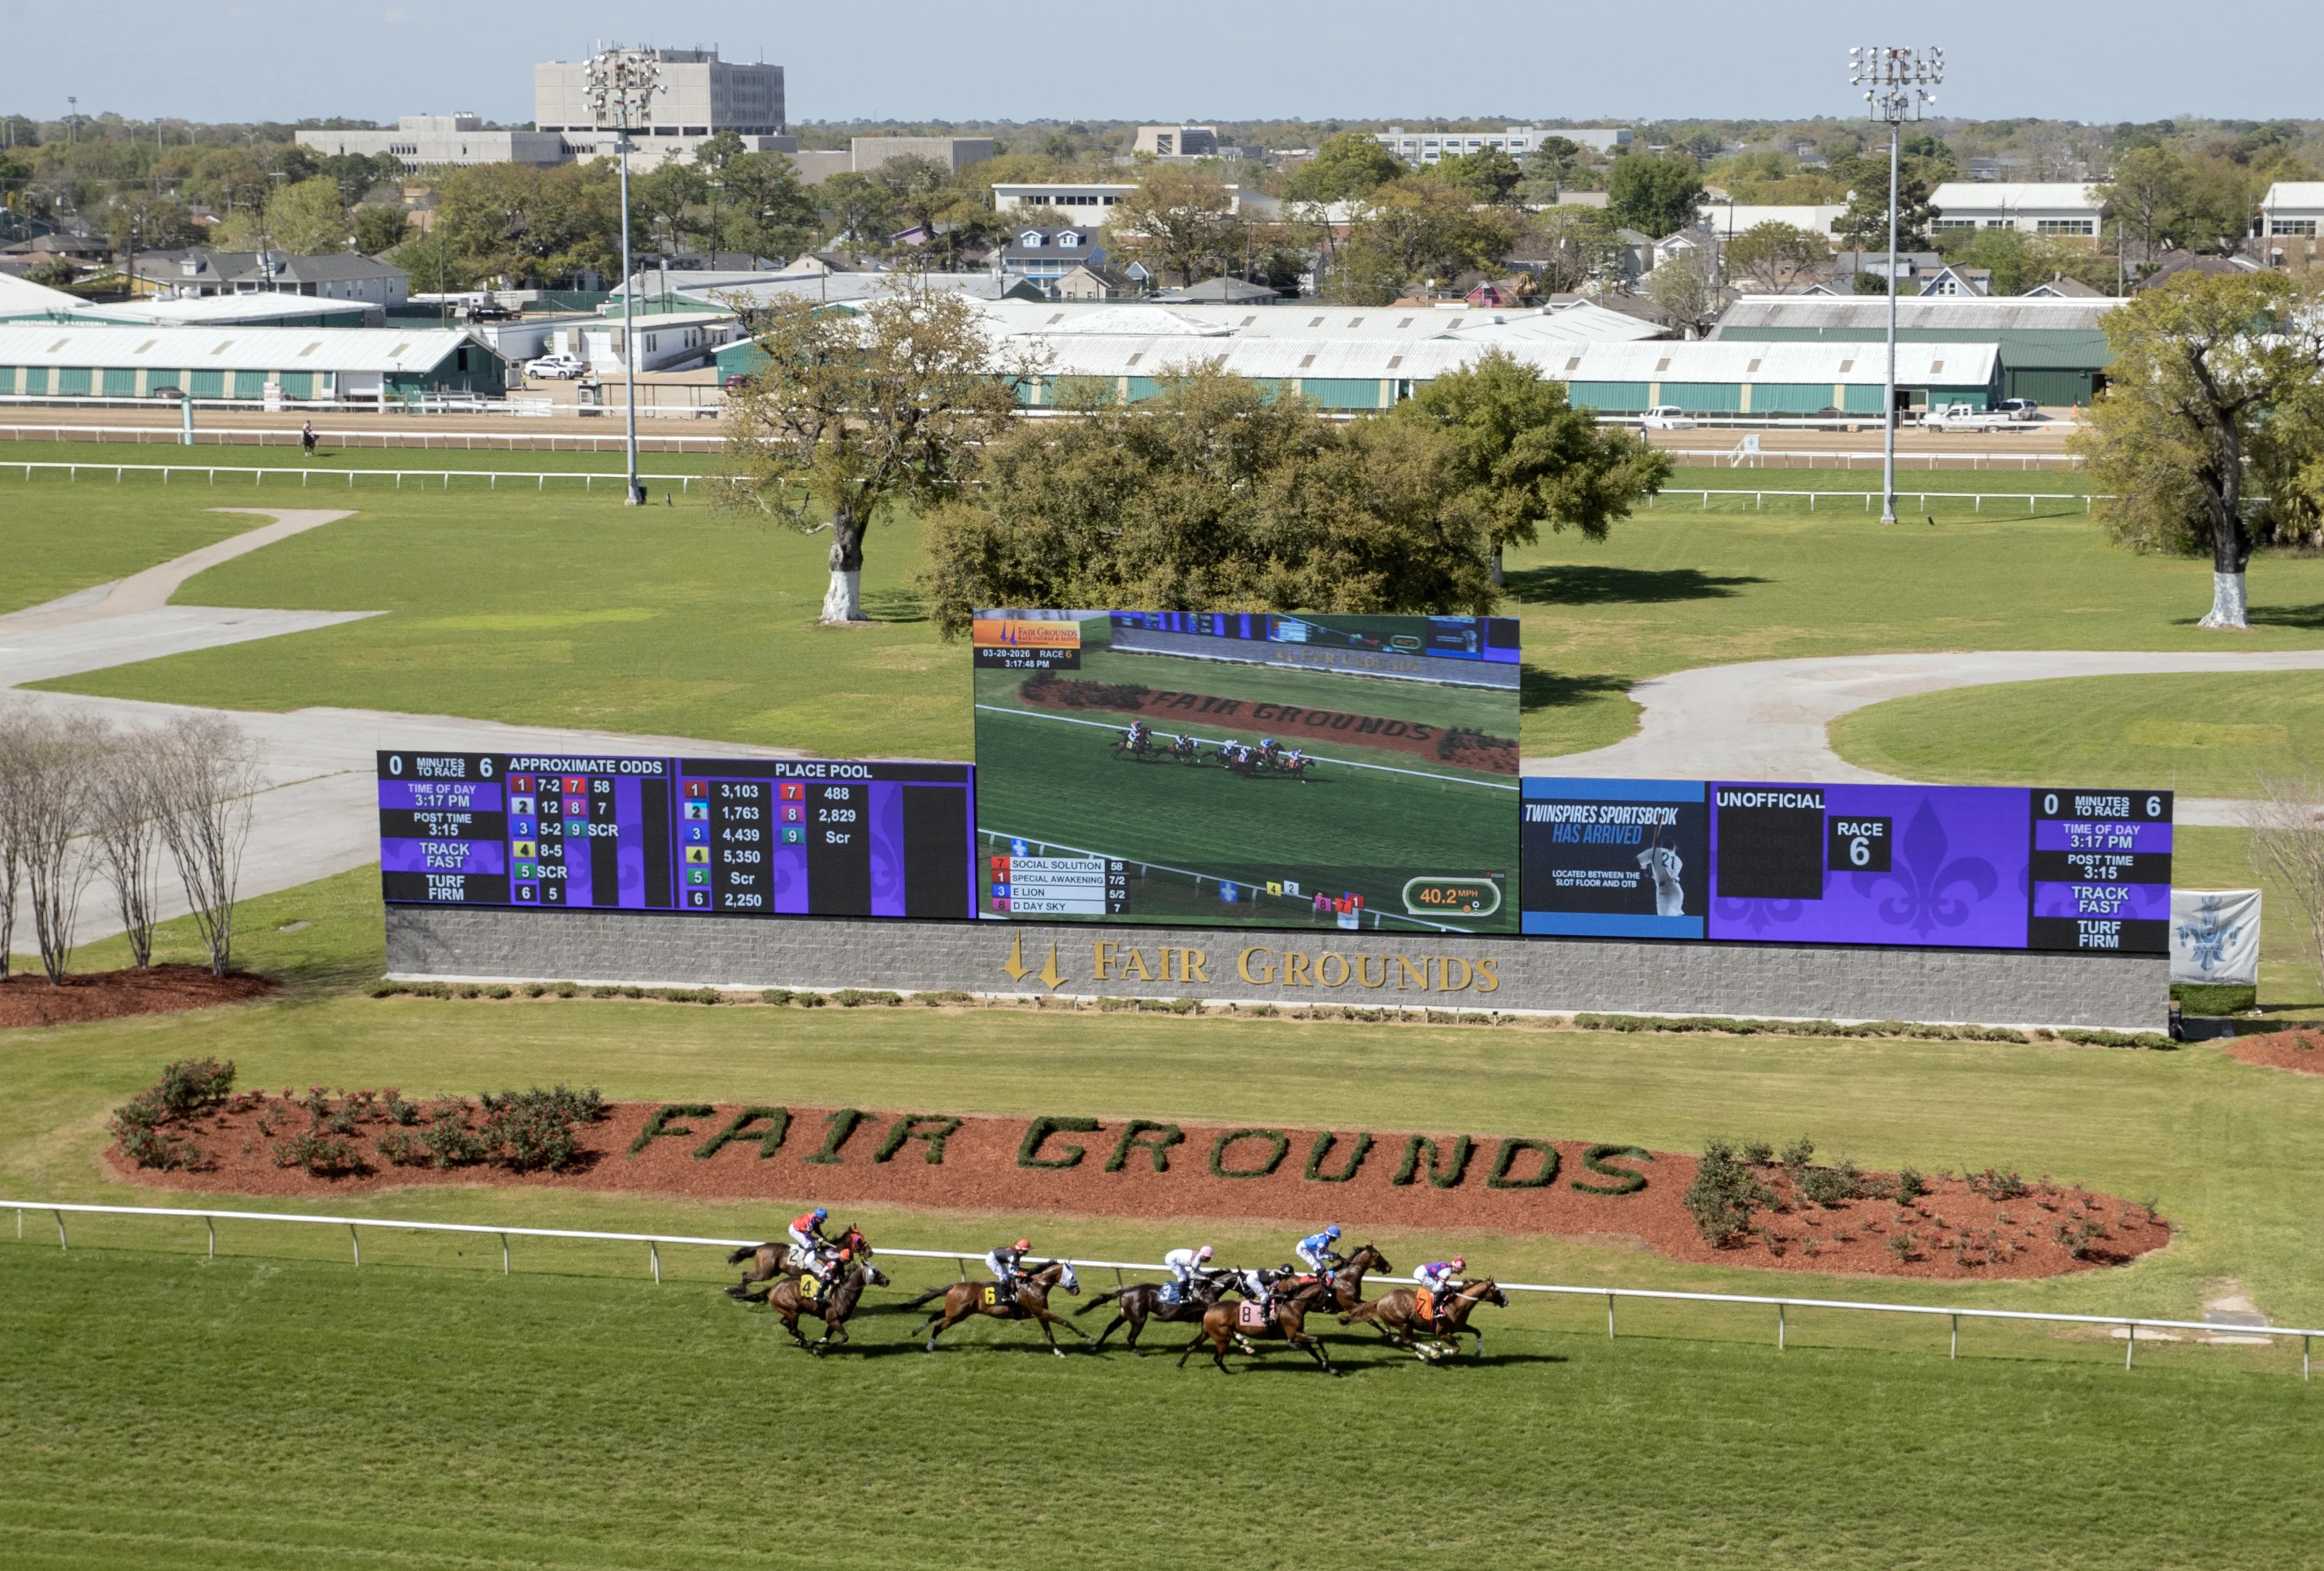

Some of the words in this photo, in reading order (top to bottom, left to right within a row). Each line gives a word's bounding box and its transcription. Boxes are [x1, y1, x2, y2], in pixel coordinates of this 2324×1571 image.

[1018, 627, 1035, 636] FAIR
[1037, 627, 1077, 636] GROUNDS
[1150, 690, 1239, 716] FAIR
[1251, 702, 1436, 741] GROUNDS
[389, 755, 402, 775] 0
[417, 758, 465, 768] MINUTES
[480, 758, 493, 777] 6
[509, 758, 615, 773] APPROXIMATE
[619, 760, 663, 773] ODDS
[417, 768, 431, 777] TO
[433, 768, 465, 777] RACE
[776, 764, 825, 777] PLACE
[830, 766, 872, 778] POOL
[408, 784, 434, 793] TIME
[436, 785, 451, 793] OF
[454, 785, 476, 795] DAY
[518, 779, 525, 791] 1
[538, 781, 560, 792] 7-2
[571, 781, 579, 792] 7
[594, 781, 610, 793] 58
[692, 785, 698, 796] 1
[721, 785, 759, 798] 3,103
[789, 787, 796, 798] 7
[824, 788, 849, 800] 488
[416, 795, 445, 807] 3:17
[448, 796, 470, 808] PM
[519, 800, 527, 813] 2
[542, 801, 558, 813] 12
[572, 802, 580, 814] 8
[598, 803, 606, 815] 7
[1717, 792, 1825, 809] UNOFFICIAL
[2044, 794, 2058, 815] 0
[2075, 796, 2129, 806] MINUTES
[2146, 796, 2161, 817] 6
[414, 813, 443, 822] POST
[446, 814, 472, 823] TIME
[692, 805, 700, 818] 2
[723, 807, 759, 820] 1,763
[789, 809, 796, 820] 8
[819, 809, 856, 822] 2,829
[1526, 804, 1597, 823] TWINSPIRES
[1599, 806, 1678, 825] SPORTSBOOK
[2075, 806, 2091, 816] TO
[2095, 806, 2129, 817] RACE
[429, 824, 458, 835] 3:15
[519, 822, 528, 834] 3
[540, 824, 561, 835] 5-2
[572, 824, 580, 835] 9
[588, 824, 619, 837] SCR
[693, 828, 700, 839] 3
[723, 829, 759, 841] 4,439
[789, 831, 797, 843] 9
[826, 831, 850, 843] Scr
[1552, 824, 1580, 843] HAS
[1582, 824, 1642, 845] ARRIVED
[1837, 822, 1883, 836] RACE
[2063, 824, 2091, 834] TIME
[2096, 824, 2112, 835] OF
[2116, 826, 2140, 835] DAY
[419, 842, 470, 856] TRACK
[2070, 835, 2101, 848] 3:17
[2108, 836, 2133, 849] PM
[520, 844, 529, 856] 4
[541, 845, 562, 856] 8-5
[693, 849, 702, 861] 4
[723, 851, 760, 864] 5,350
[1850, 836, 1870, 866] 6
[427, 856, 463, 868] FAST
[998, 859, 1004, 867] 7
[1052, 862, 1101, 870] SOLUTION
[1661, 852, 1675, 869] 21
[2069, 854, 2101, 865] POST
[2104, 855, 2133, 866] TIME
[521, 866, 529, 877] 5
[537, 866, 567, 879] SCR
[695, 872, 702, 883] 5
[730, 873, 754, 884] Scr
[998, 873, 1004, 881] 1
[1588, 871, 1624, 879] BETWEEN
[2084, 866, 2118, 879] 3:15
[426, 875, 465, 887] TURF
[429, 888, 464, 901] FIRM
[521, 887, 531, 899] 6
[549, 888, 557, 899] 5
[998, 887, 1005, 896] 3
[1270, 885, 1277, 894] 4
[1289, 884, 1294, 893] 2
[2072, 886, 2129, 900] TRACK
[695, 893, 703, 905] 6
[725, 894, 762, 907] 2,250
[1354, 897, 1358, 907] 1
[1420, 888, 1457, 904] 40.2
[1320, 899, 1326, 909] 8
[1341, 901, 1345, 911] 7
[2079, 901, 2121, 913] FAST
[2077, 920, 2121, 933] TURF
[2079, 934, 2119, 948] FIRM
[1092, 941, 1209, 983] FAIR
[1237, 945, 1501, 992] GROUNDS
[625, 1104, 964, 1165] FAIR
[1015, 1116, 1655, 1195] GROUNDS
[789, 1249, 798, 1262] 2
[802, 1280, 811, 1294] 4
[1159, 1285, 1171, 1301] 3
[985, 1287, 996, 1304] 6
[1418, 1298, 1426, 1312] 7
[1243, 1307, 1251, 1322] 8
